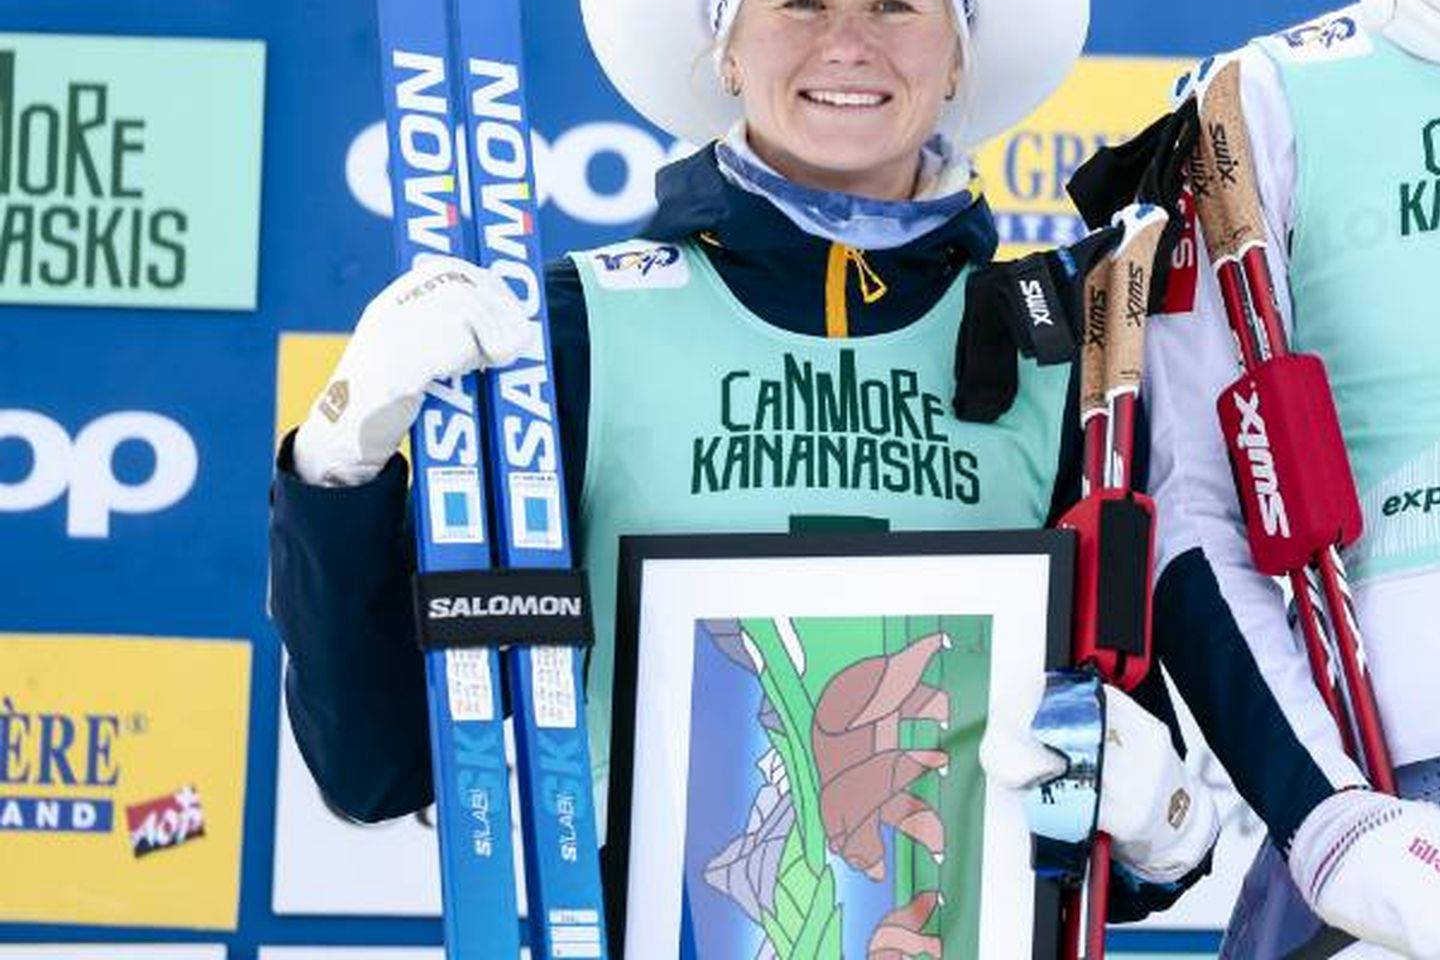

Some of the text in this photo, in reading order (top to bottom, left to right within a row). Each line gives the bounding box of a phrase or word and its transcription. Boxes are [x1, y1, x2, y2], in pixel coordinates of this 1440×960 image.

[721, 349, 949, 443] CANMORE
[691, 435, 981, 505] KANANASKIS
[428, 595, 581, 618] SALOMON
[0, 800, 97, 828] AND
